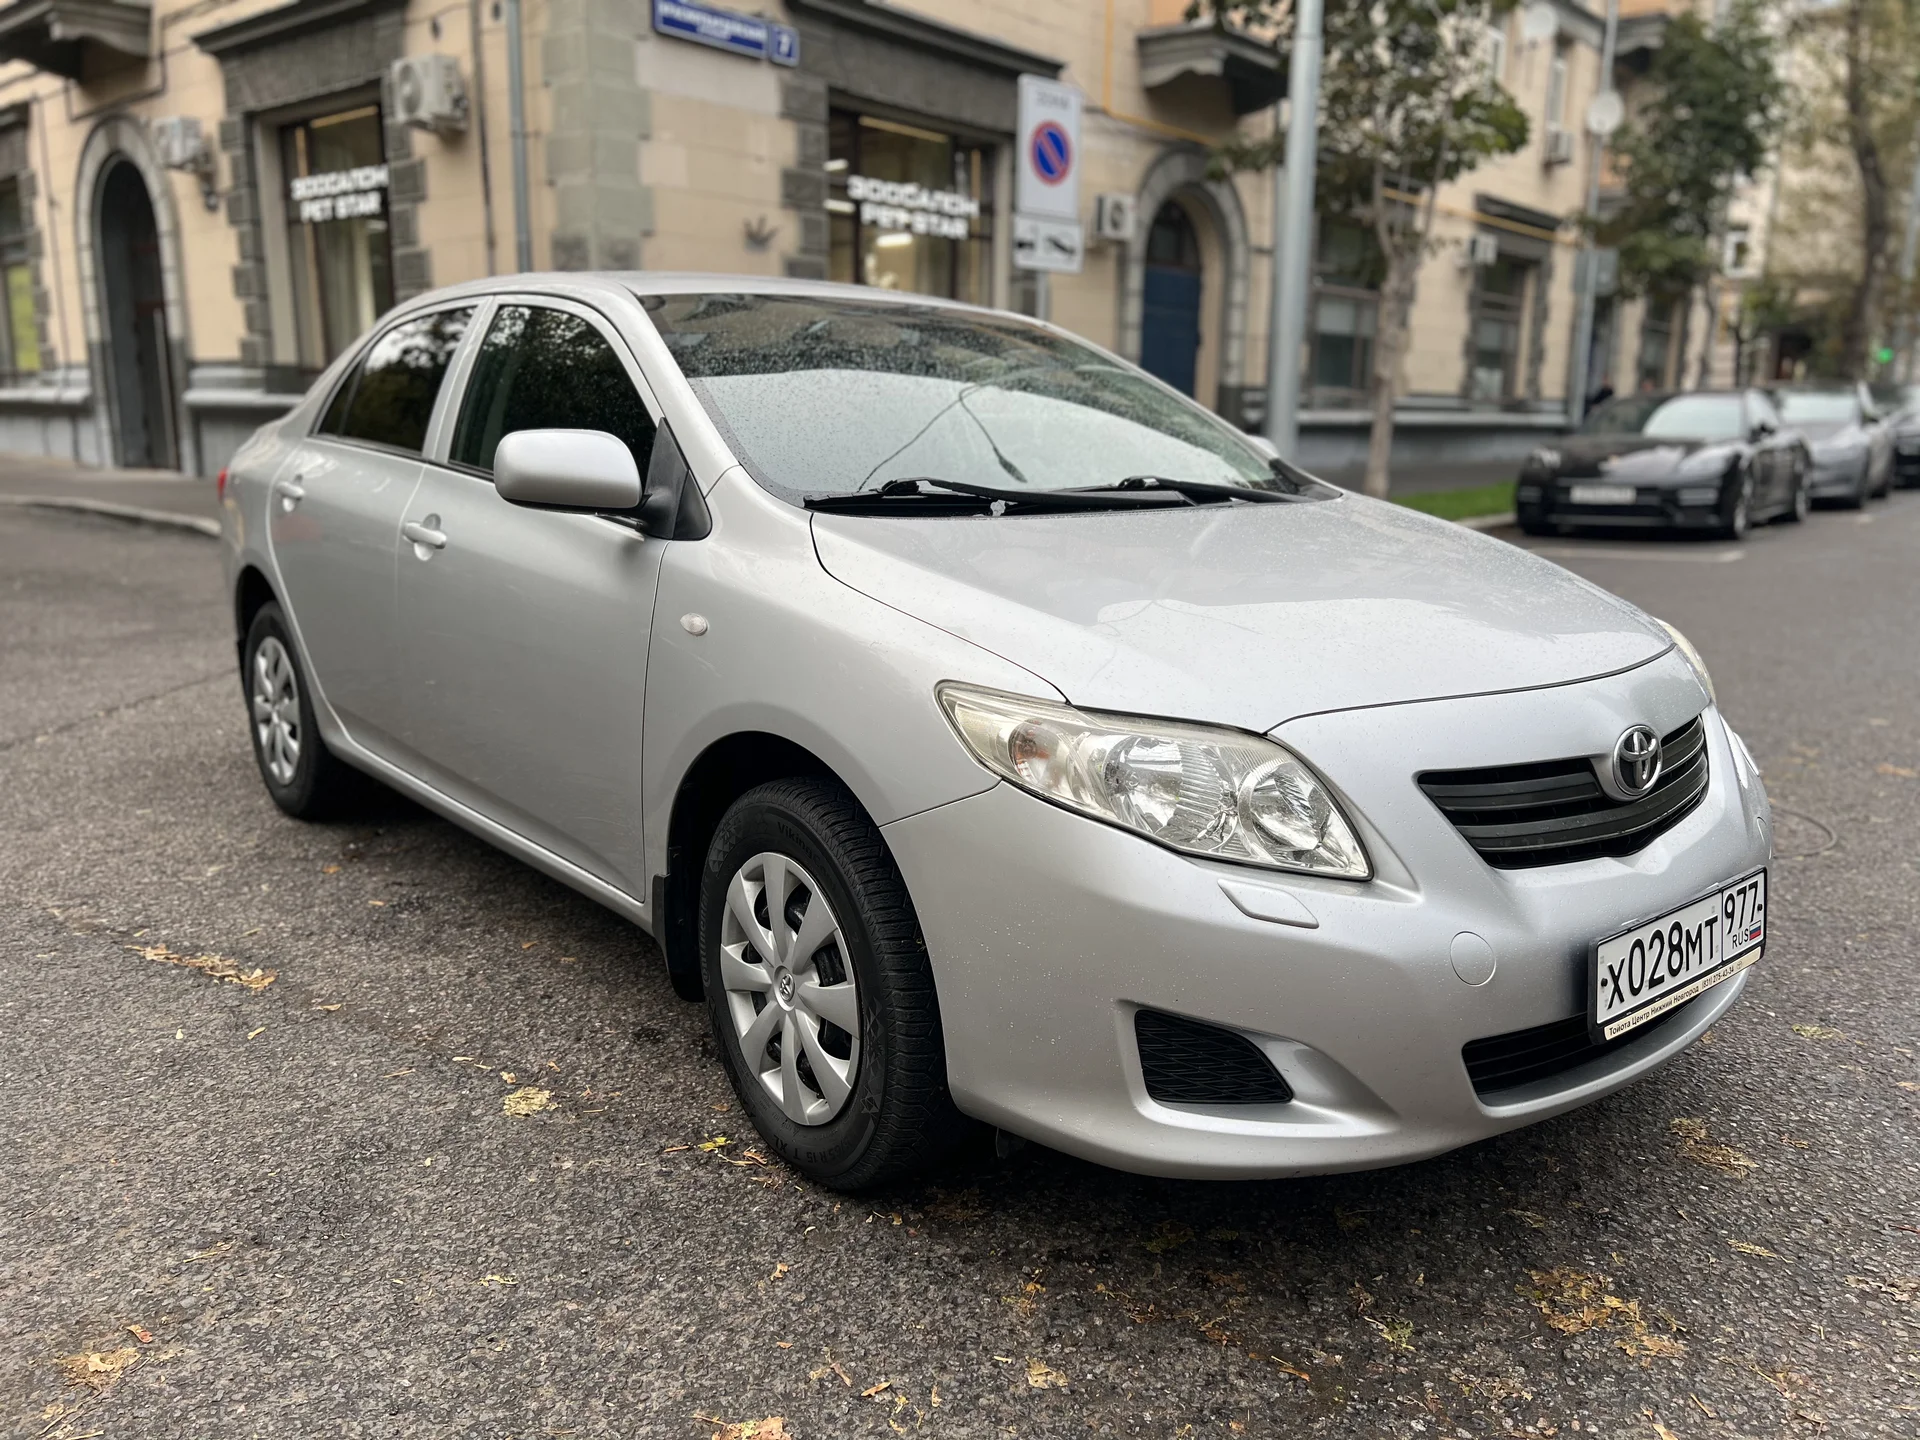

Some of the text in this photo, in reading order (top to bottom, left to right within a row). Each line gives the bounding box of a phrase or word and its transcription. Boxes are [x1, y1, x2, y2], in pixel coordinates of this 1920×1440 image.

[291, 164, 388, 201] ЗООСАЛОН
[847, 174, 979, 217] ЗООСАЛОН
[300, 191, 381, 223] PET STAR
[860, 203, 968, 240] PET STAR
[1724, 880, 1758, 935] 977
[1732, 928, 1749, 950] RUS
[1609, 1020, 1631, 1036] Тойота
[1631, 1012, 1651, 1027] Центр
[1650, 999, 1673, 1018] Нижний
[1673, 985, 1700, 1004] Новгород
